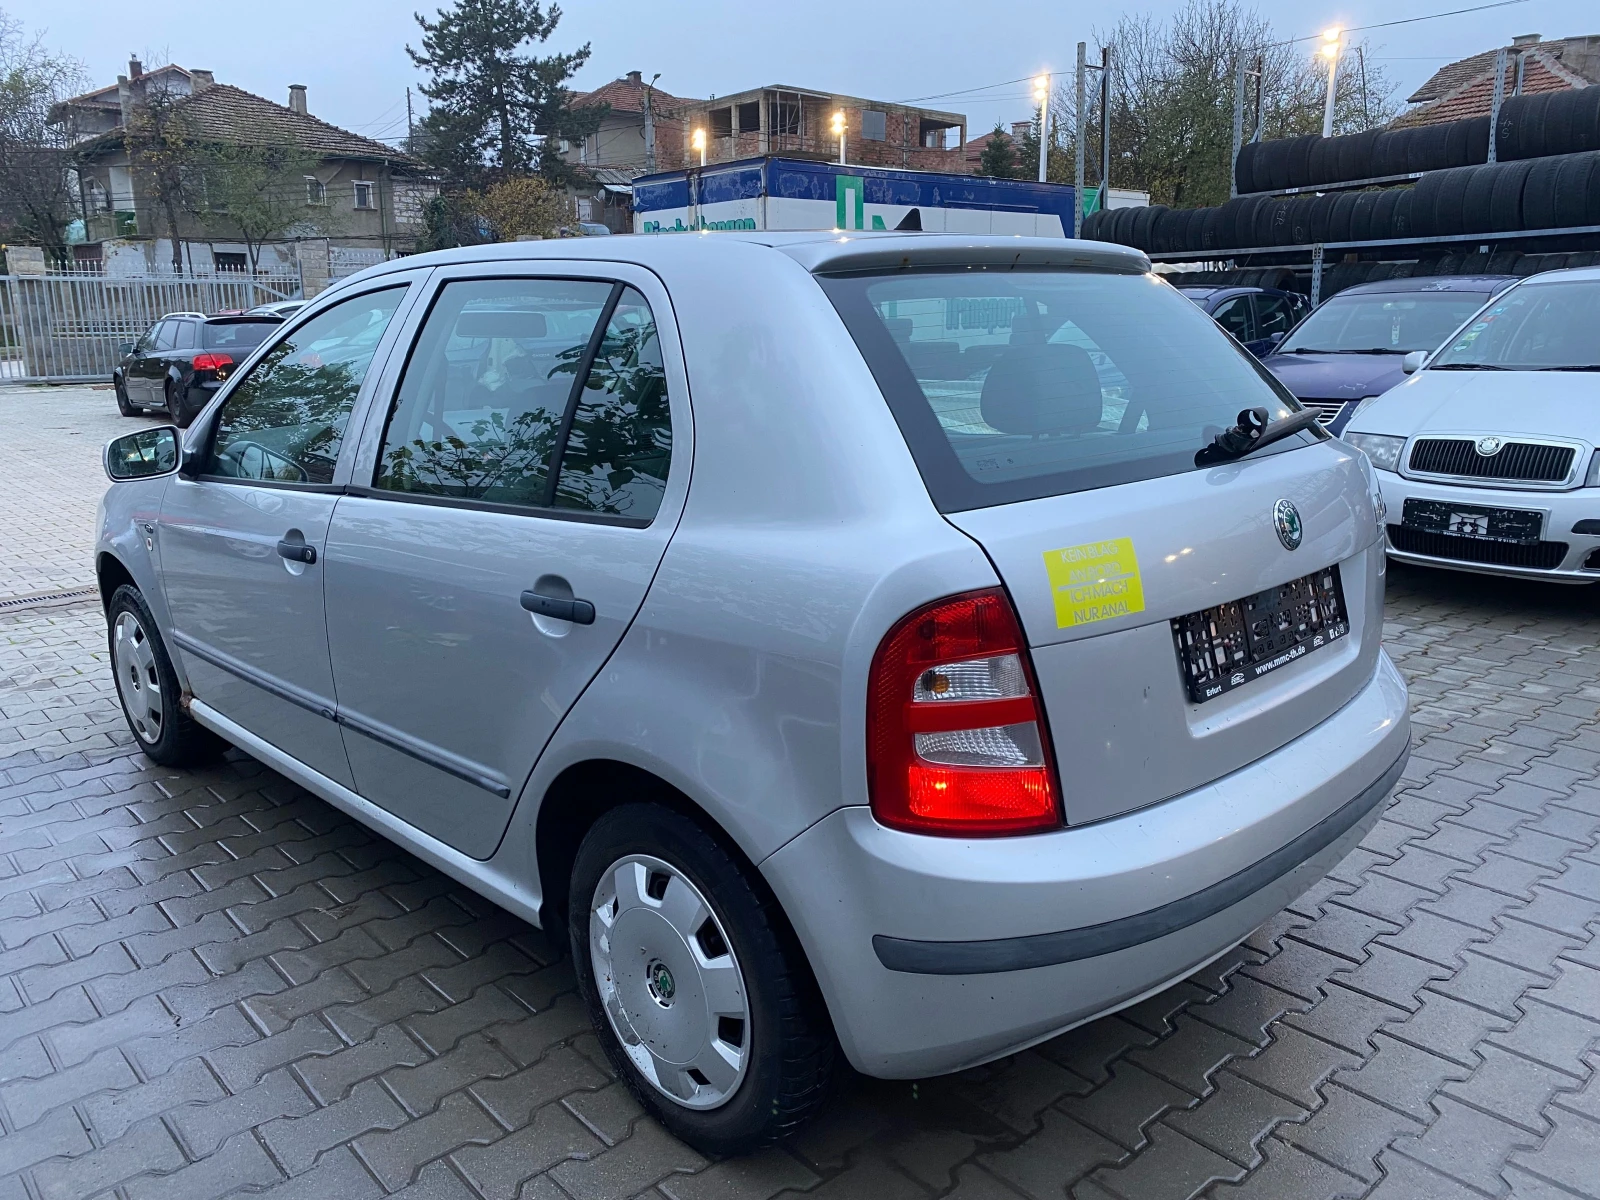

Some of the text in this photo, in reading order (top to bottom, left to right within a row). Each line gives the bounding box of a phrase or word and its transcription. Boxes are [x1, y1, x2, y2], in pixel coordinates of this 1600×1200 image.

[1060, 547, 1087, 563] KEIN
[1070, 580, 1128, 603] ICH MACH
[1074, 600, 1130, 623] NUR ANAL
[1255, 645, 1306, 675] www.mmc-th.de
